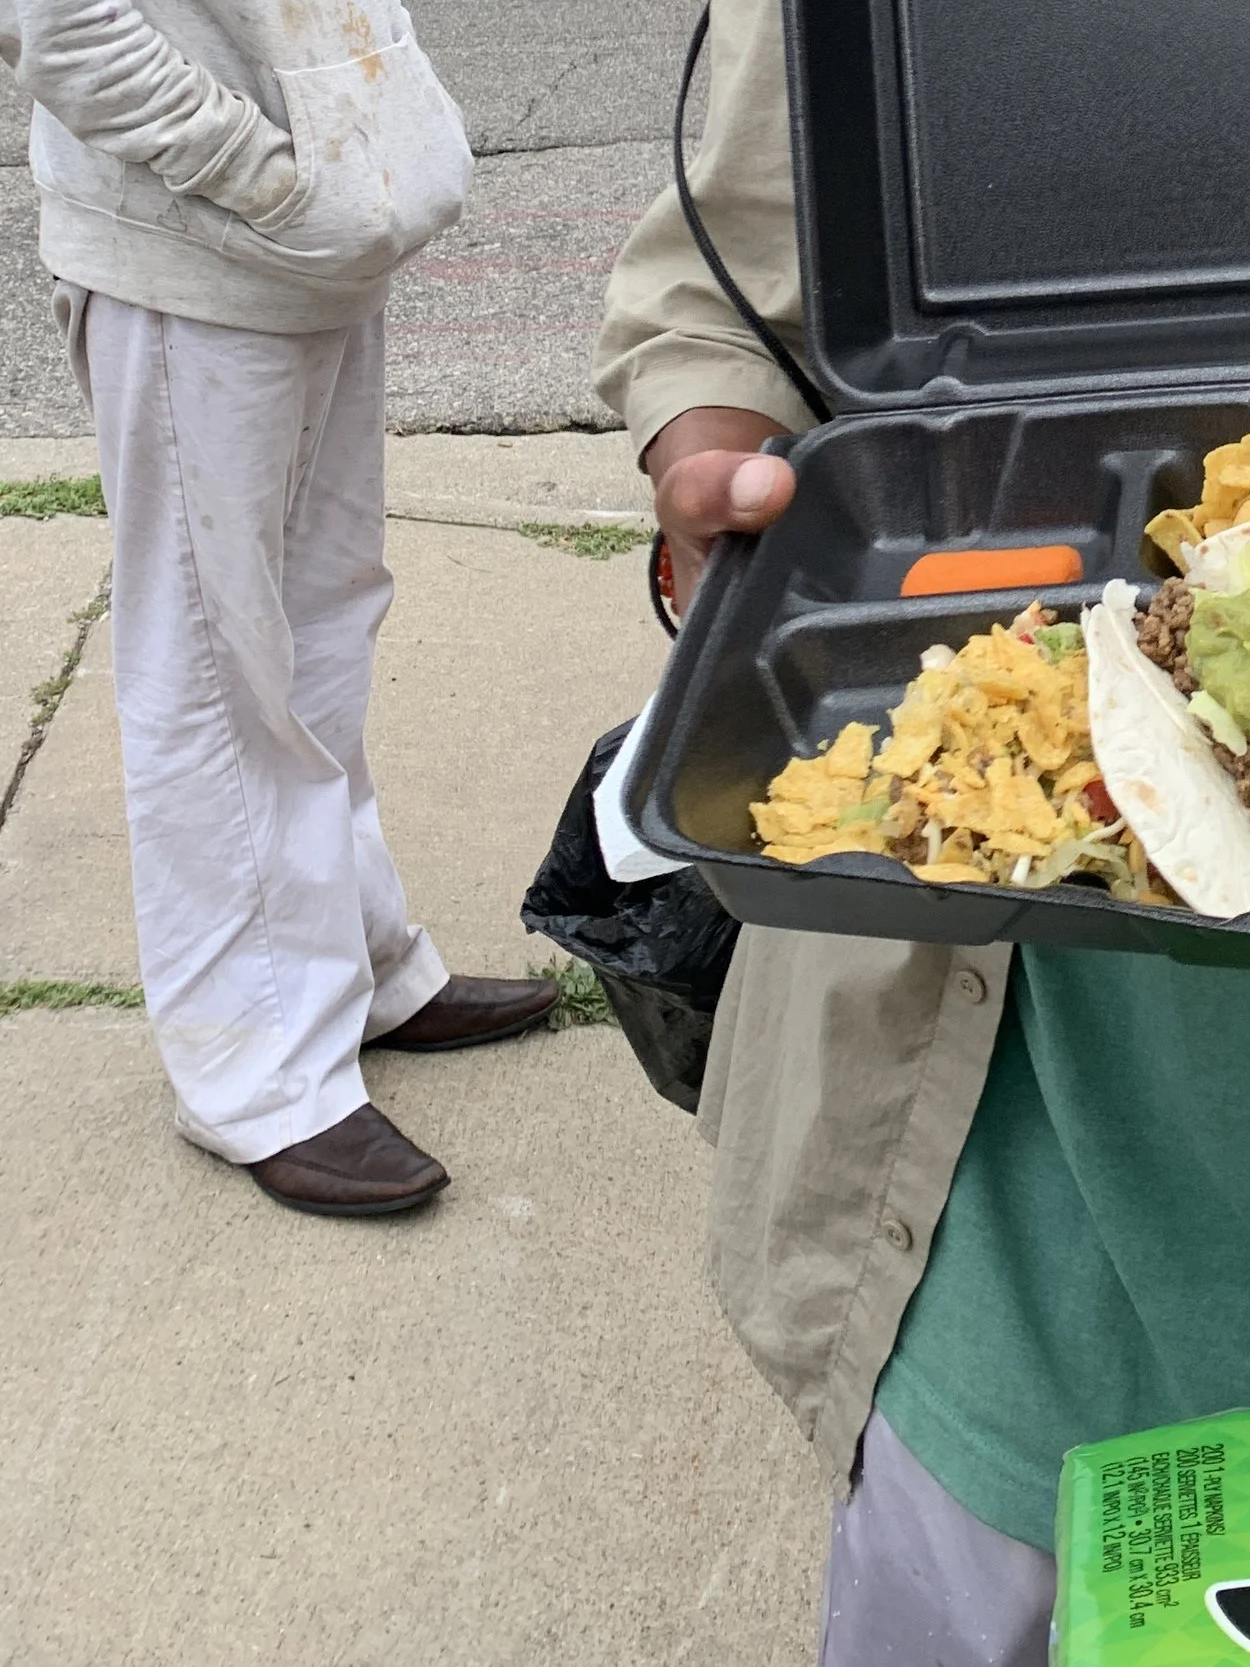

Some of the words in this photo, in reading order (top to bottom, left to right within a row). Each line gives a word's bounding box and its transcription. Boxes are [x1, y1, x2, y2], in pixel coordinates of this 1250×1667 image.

[1176, 1447, 1200, 1468] 200
[1201, 1443, 1226, 1466] 200
[1100, 1462, 1125, 1489] (12.1
[1126, 1456, 1150, 1481] (145
[1203, 1466, 1226, 1494] 1-PLY
[1177, 1469, 1199, 1521] SERVIETTES
[1180, 1521, 1203, 1529] 1
[1203, 1494, 1226, 1536] NAPKINS/
[1102, 1524, 1127, 1543] 12
[1128, 1528, 1152, 1556] 30.7
[1153, 1513, 1174, 1563] SERVIETTE
[1128, 1558, 1144, 1574] cm
[1180, 1531, 1203, 1582] ÉPAISSEUR
[1155, 1563, 1180, 1587] 933
[1128, 1582, 1154, 1610] 30.4
[1129, 1612, 1146, 1629] cm
